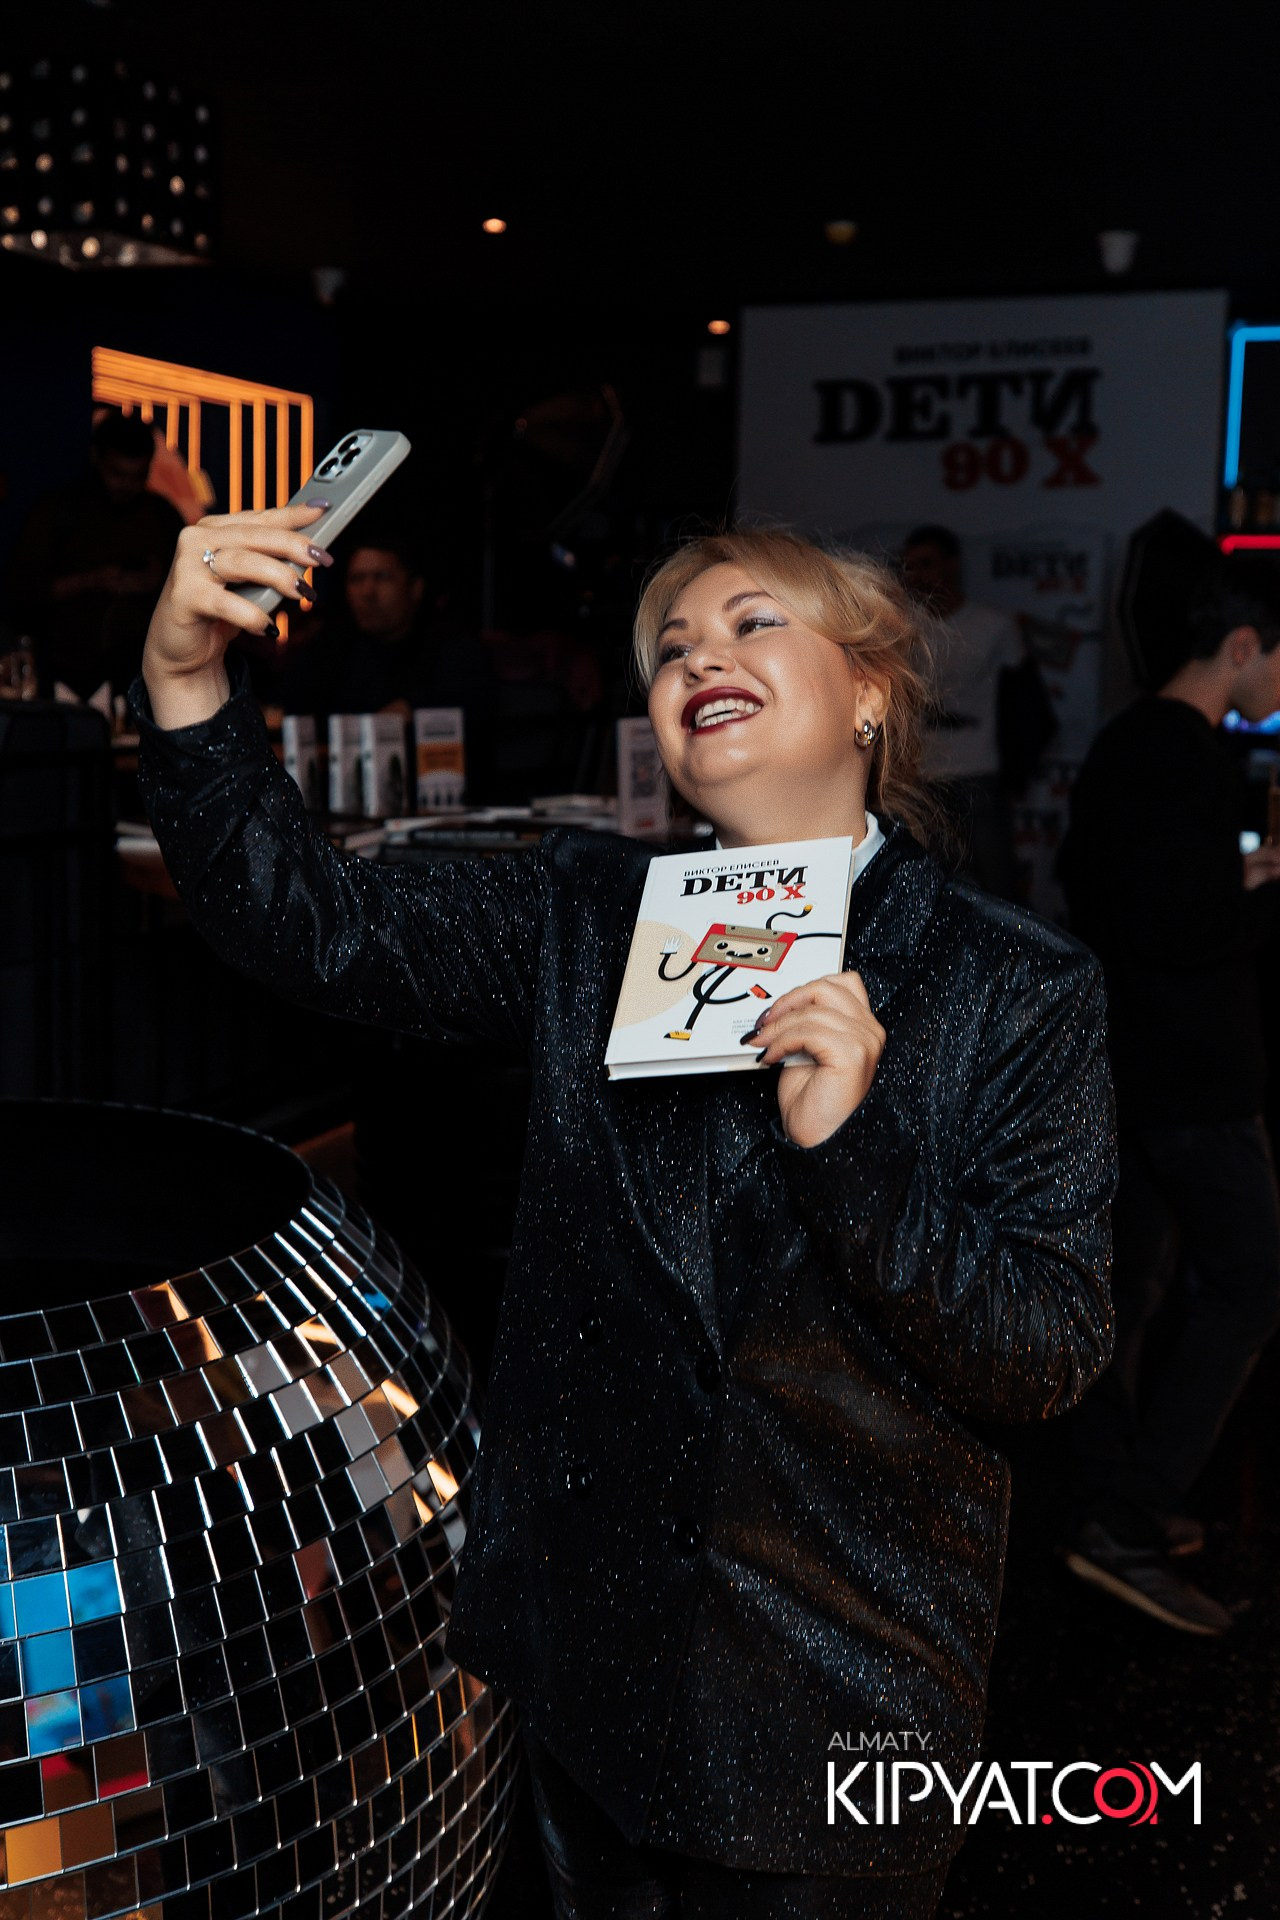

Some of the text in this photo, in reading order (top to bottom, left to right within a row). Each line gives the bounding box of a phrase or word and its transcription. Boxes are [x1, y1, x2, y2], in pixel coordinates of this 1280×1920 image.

[943, 437, 1028, 490] 90
[684, 859, 779, 877] ВИКТОР ЕЛИСЕЕВ
[737, 887, 775, 904] 90
